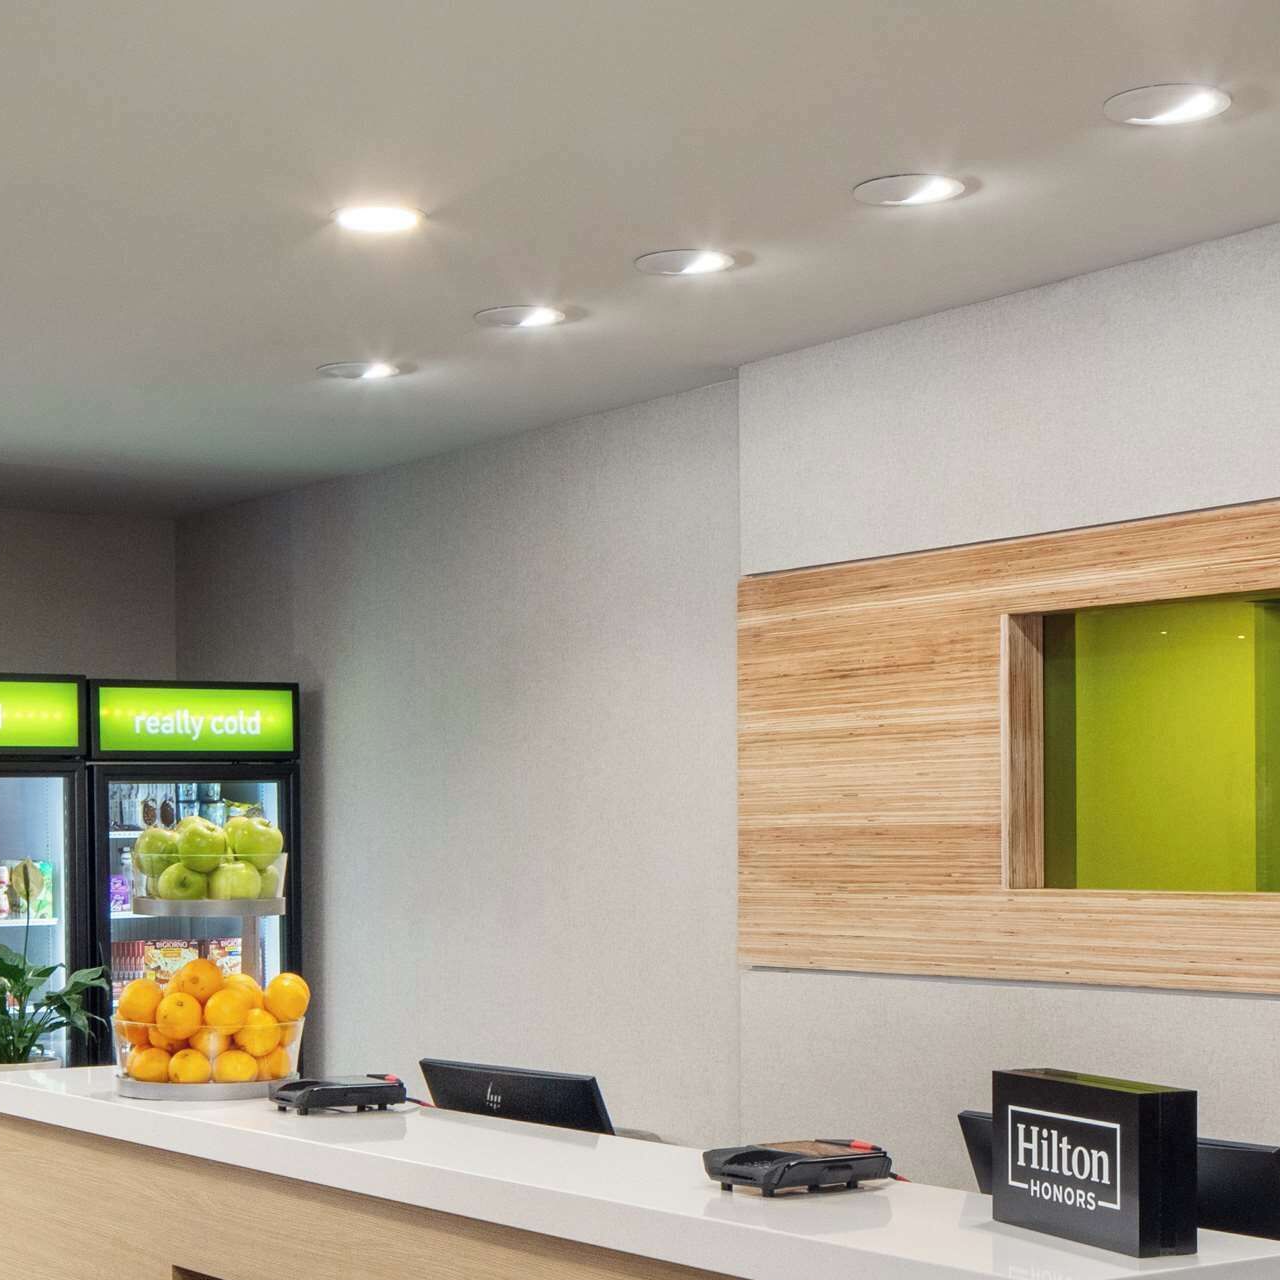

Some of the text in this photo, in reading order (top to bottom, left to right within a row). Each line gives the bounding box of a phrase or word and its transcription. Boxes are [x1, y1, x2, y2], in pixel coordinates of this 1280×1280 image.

[134, 708, 262, 740] really cold
[1016, 1123, 1111, 1185] Hilton
[1029, 1179, 1097, 1211] HONORS
